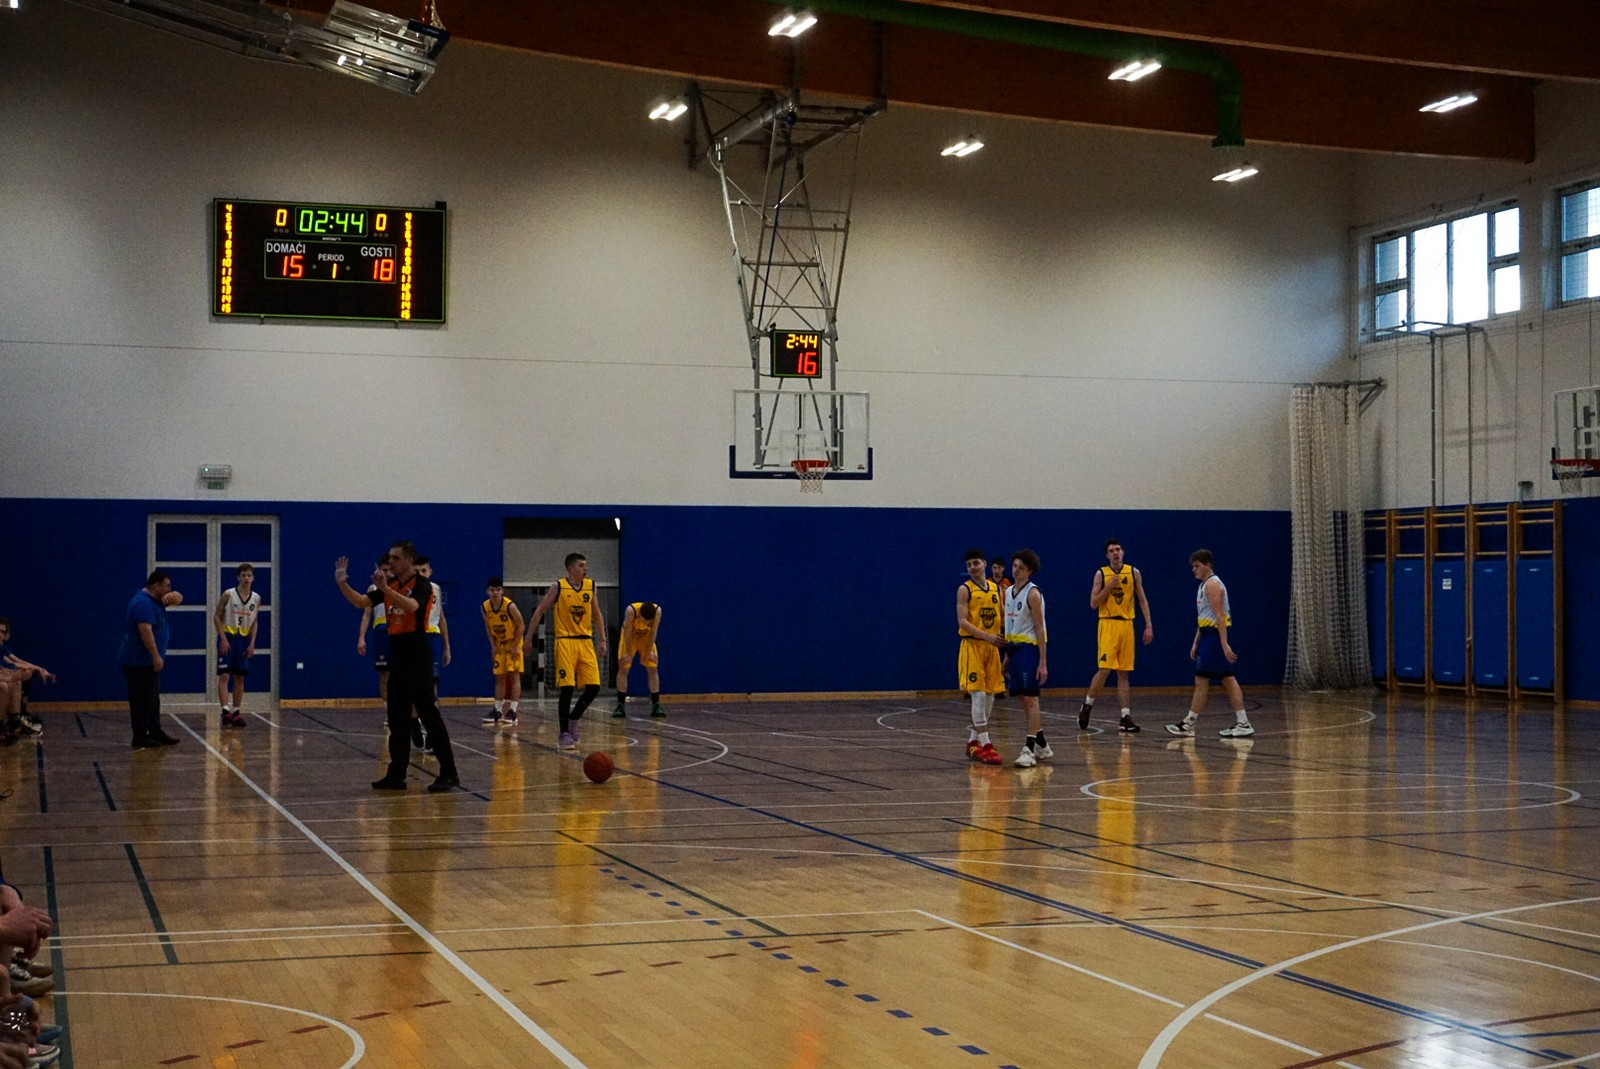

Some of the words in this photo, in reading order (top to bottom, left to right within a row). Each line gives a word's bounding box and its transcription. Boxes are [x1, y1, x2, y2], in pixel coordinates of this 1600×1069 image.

[275, 208, 288, 227] 0
[298, 209, 365, 234] 02:44
[375, 213, 388, 232] 0
[266, 241, 306, 254] DOMAĆI
[360, 246, 392, 258] GOSTI
[317, 253, 345, 262] PERIOD
[282, 254, 304, 279] 15
[331, 262, 338, 280] 1
[372, 259, 395, 284] 18
[786, 333, 818, 349] 2:44
[797, 352, 817, 375] 16
[1121, 577, 1128, 585] 4
[583, 593, 590, 603] 9
[992, 594, 998, 604] 6
[238, 616, 243, 625] 5
[1099, 653, 1107, 662] 4
[559, 669, 566, 679] 9
[968, 672, 978, 683] 6
